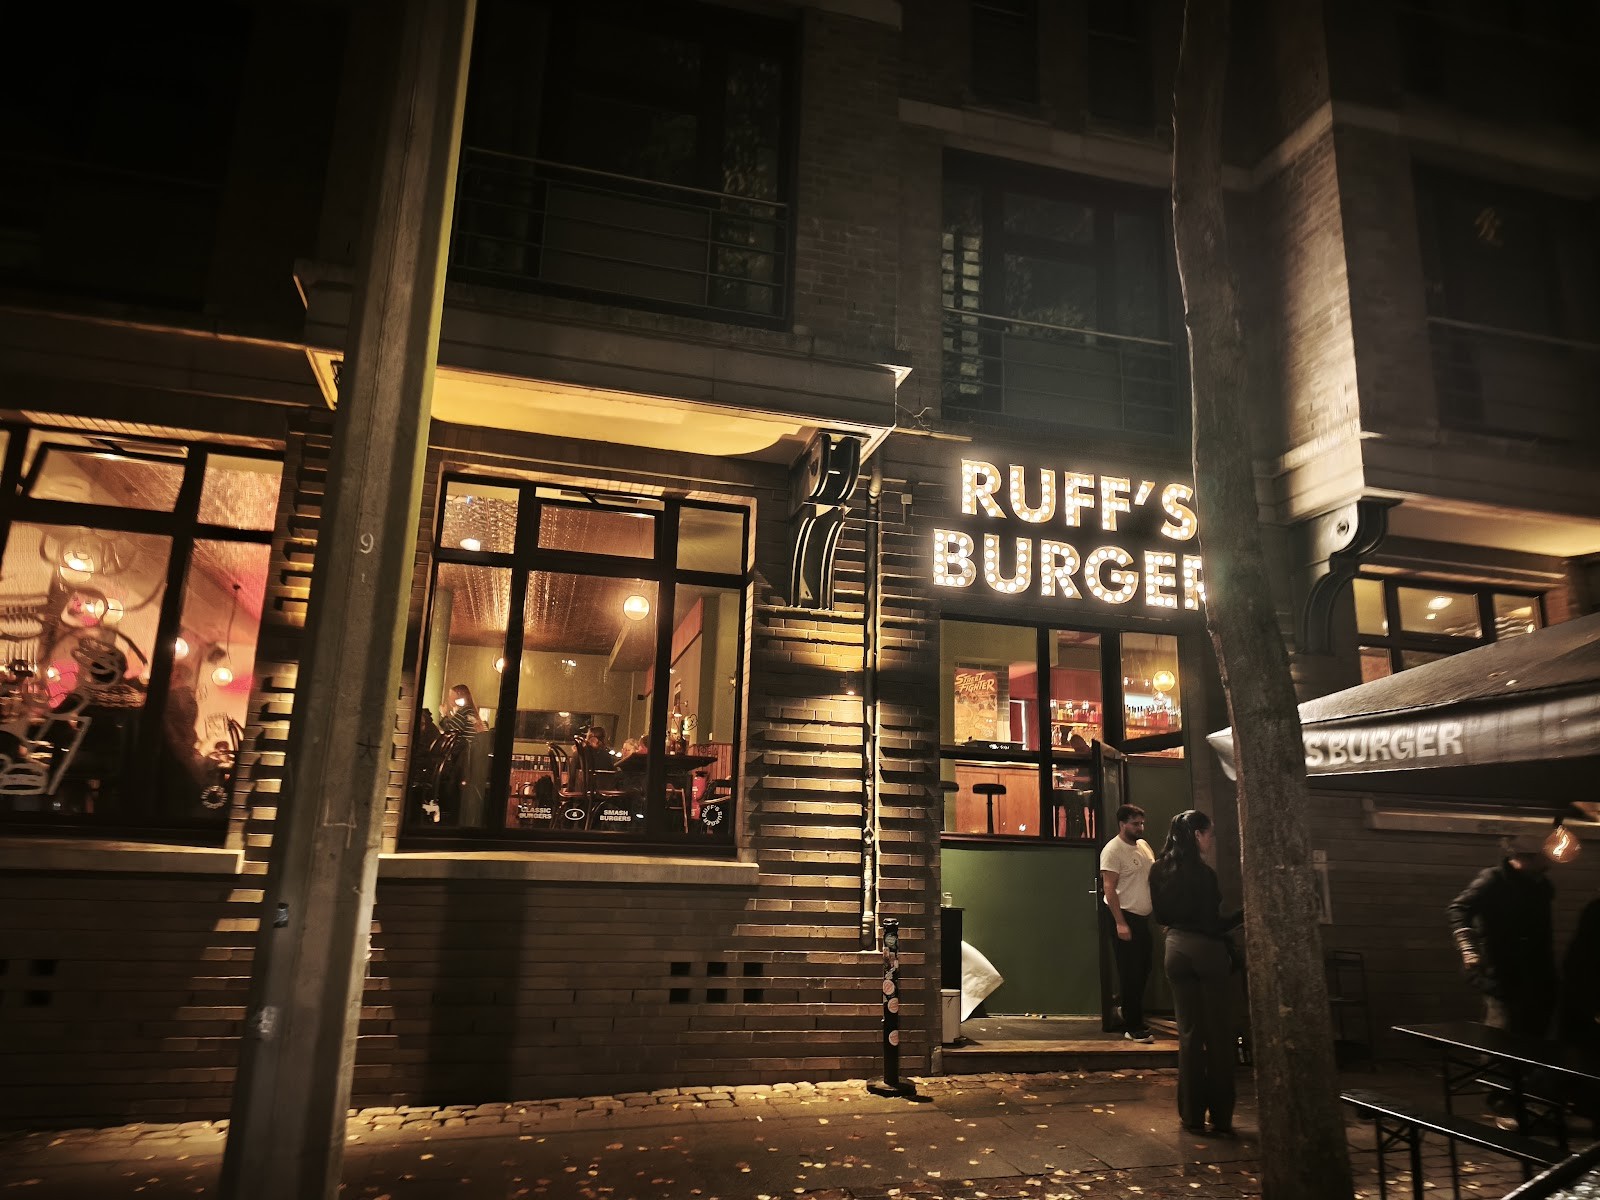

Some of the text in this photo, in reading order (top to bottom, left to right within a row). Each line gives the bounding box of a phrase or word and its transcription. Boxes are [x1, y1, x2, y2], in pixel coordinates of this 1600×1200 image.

[960, 458, 1198, 541] RUFF'S
[958, 679, 996, 693] FIGHTER
[1327, 722, 1464, 765] BURGER
